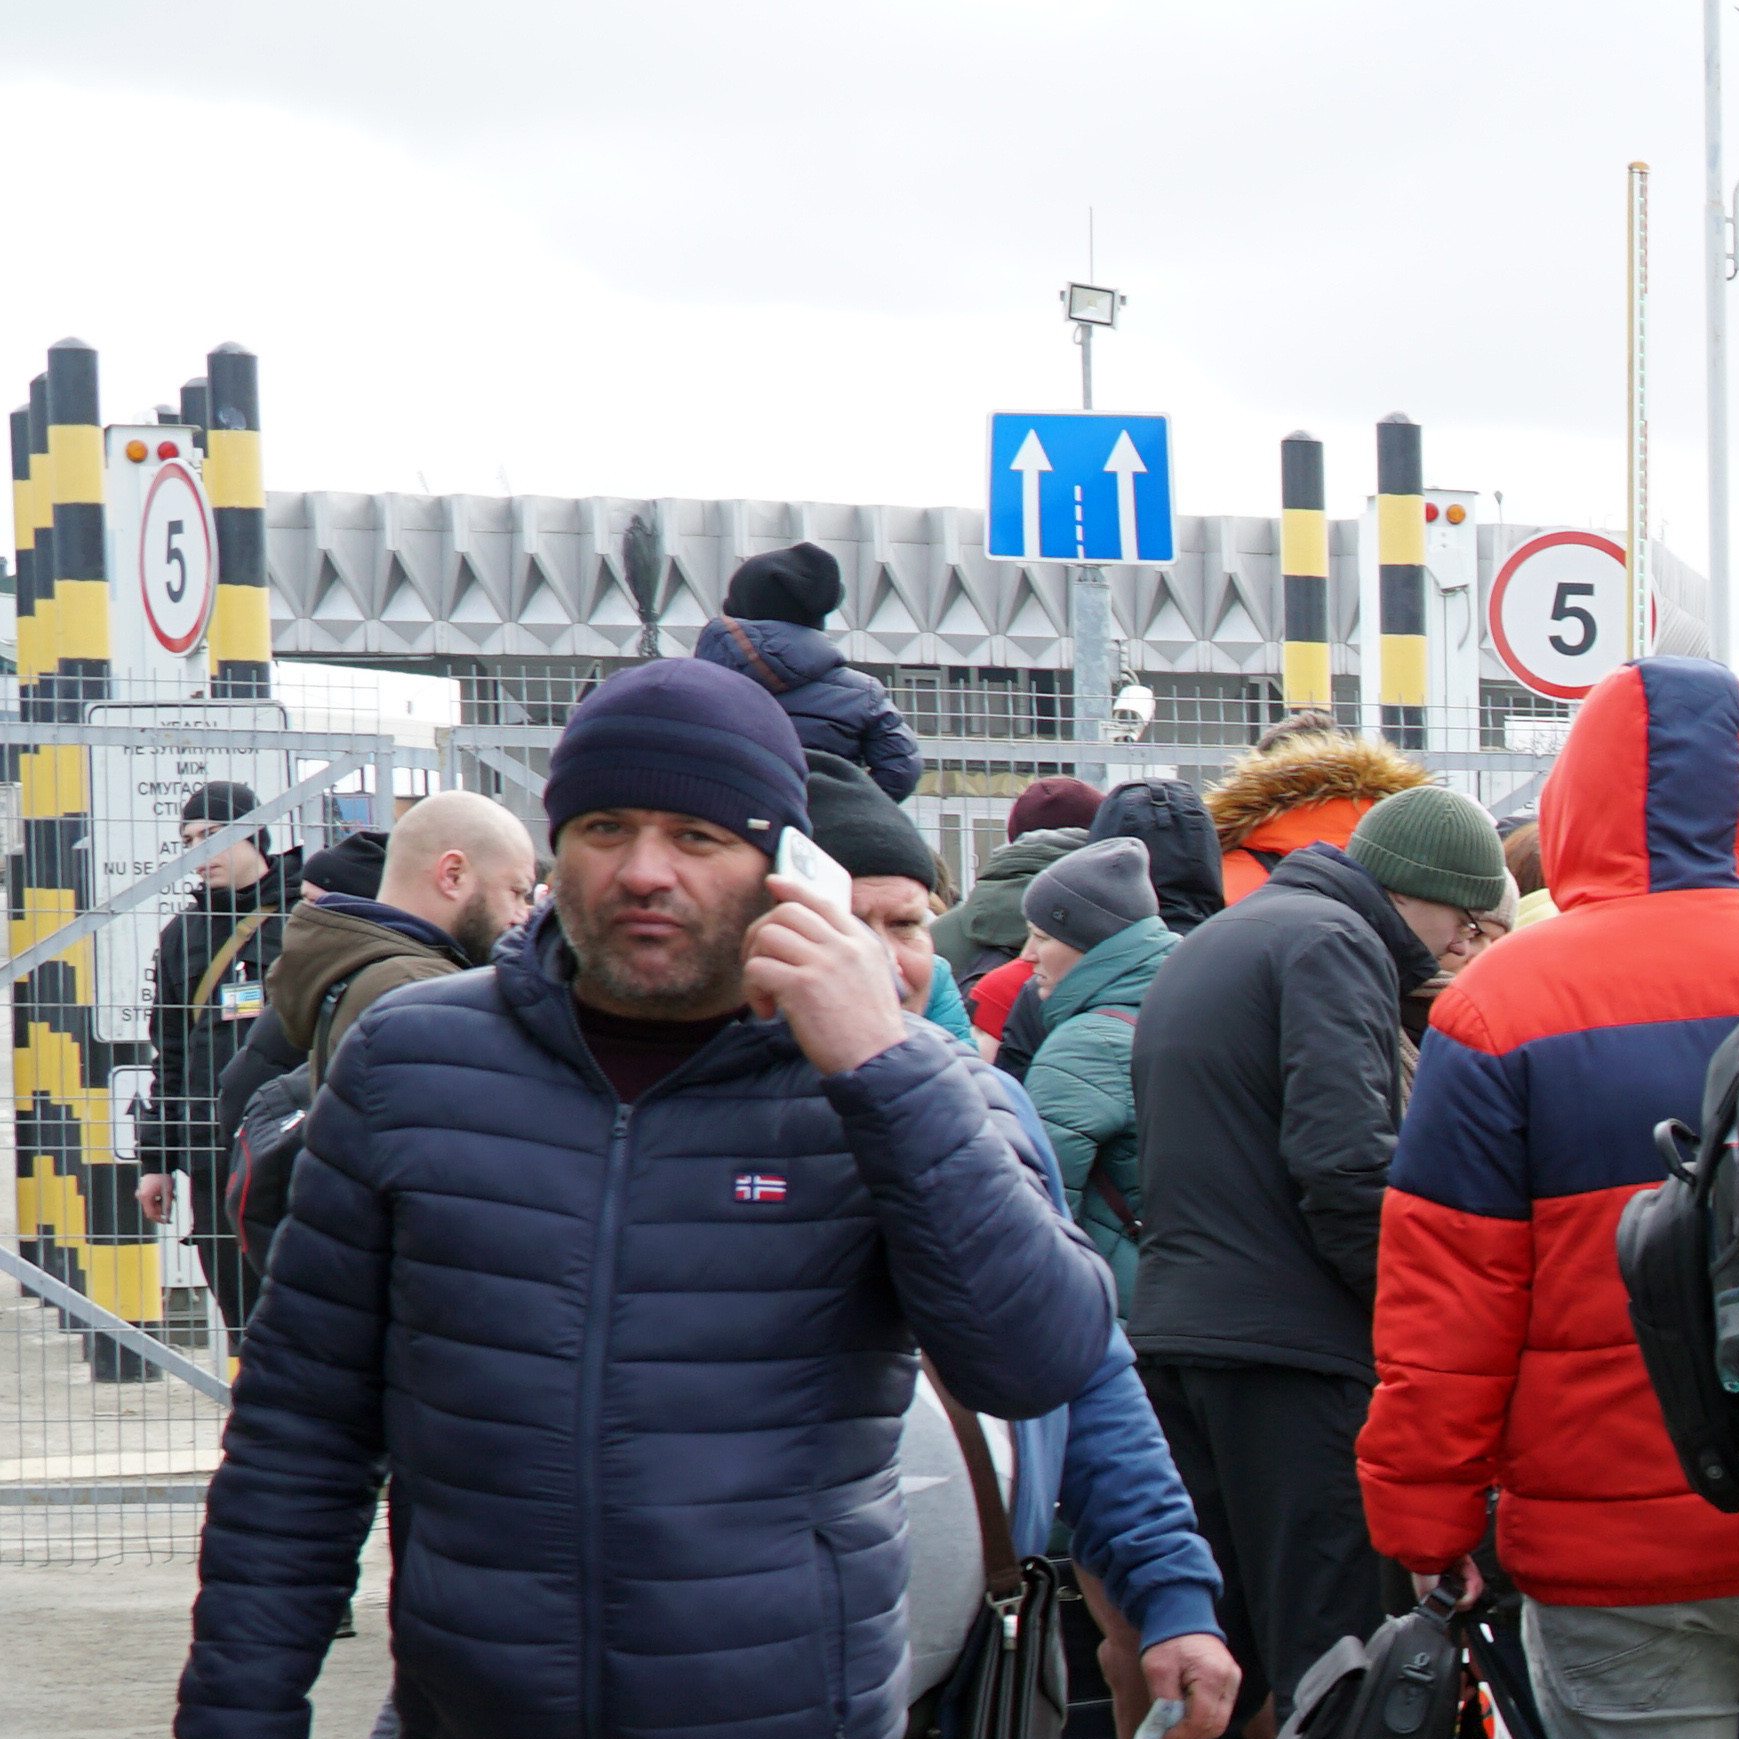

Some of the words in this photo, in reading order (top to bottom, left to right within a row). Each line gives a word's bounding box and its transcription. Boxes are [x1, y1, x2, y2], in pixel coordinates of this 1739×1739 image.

[166, 520, 186, 603] 5
[1549, 583, 1597, 656] 5
[104, 861, 126, 875] NU
[133, 861, 153, 875] SE
